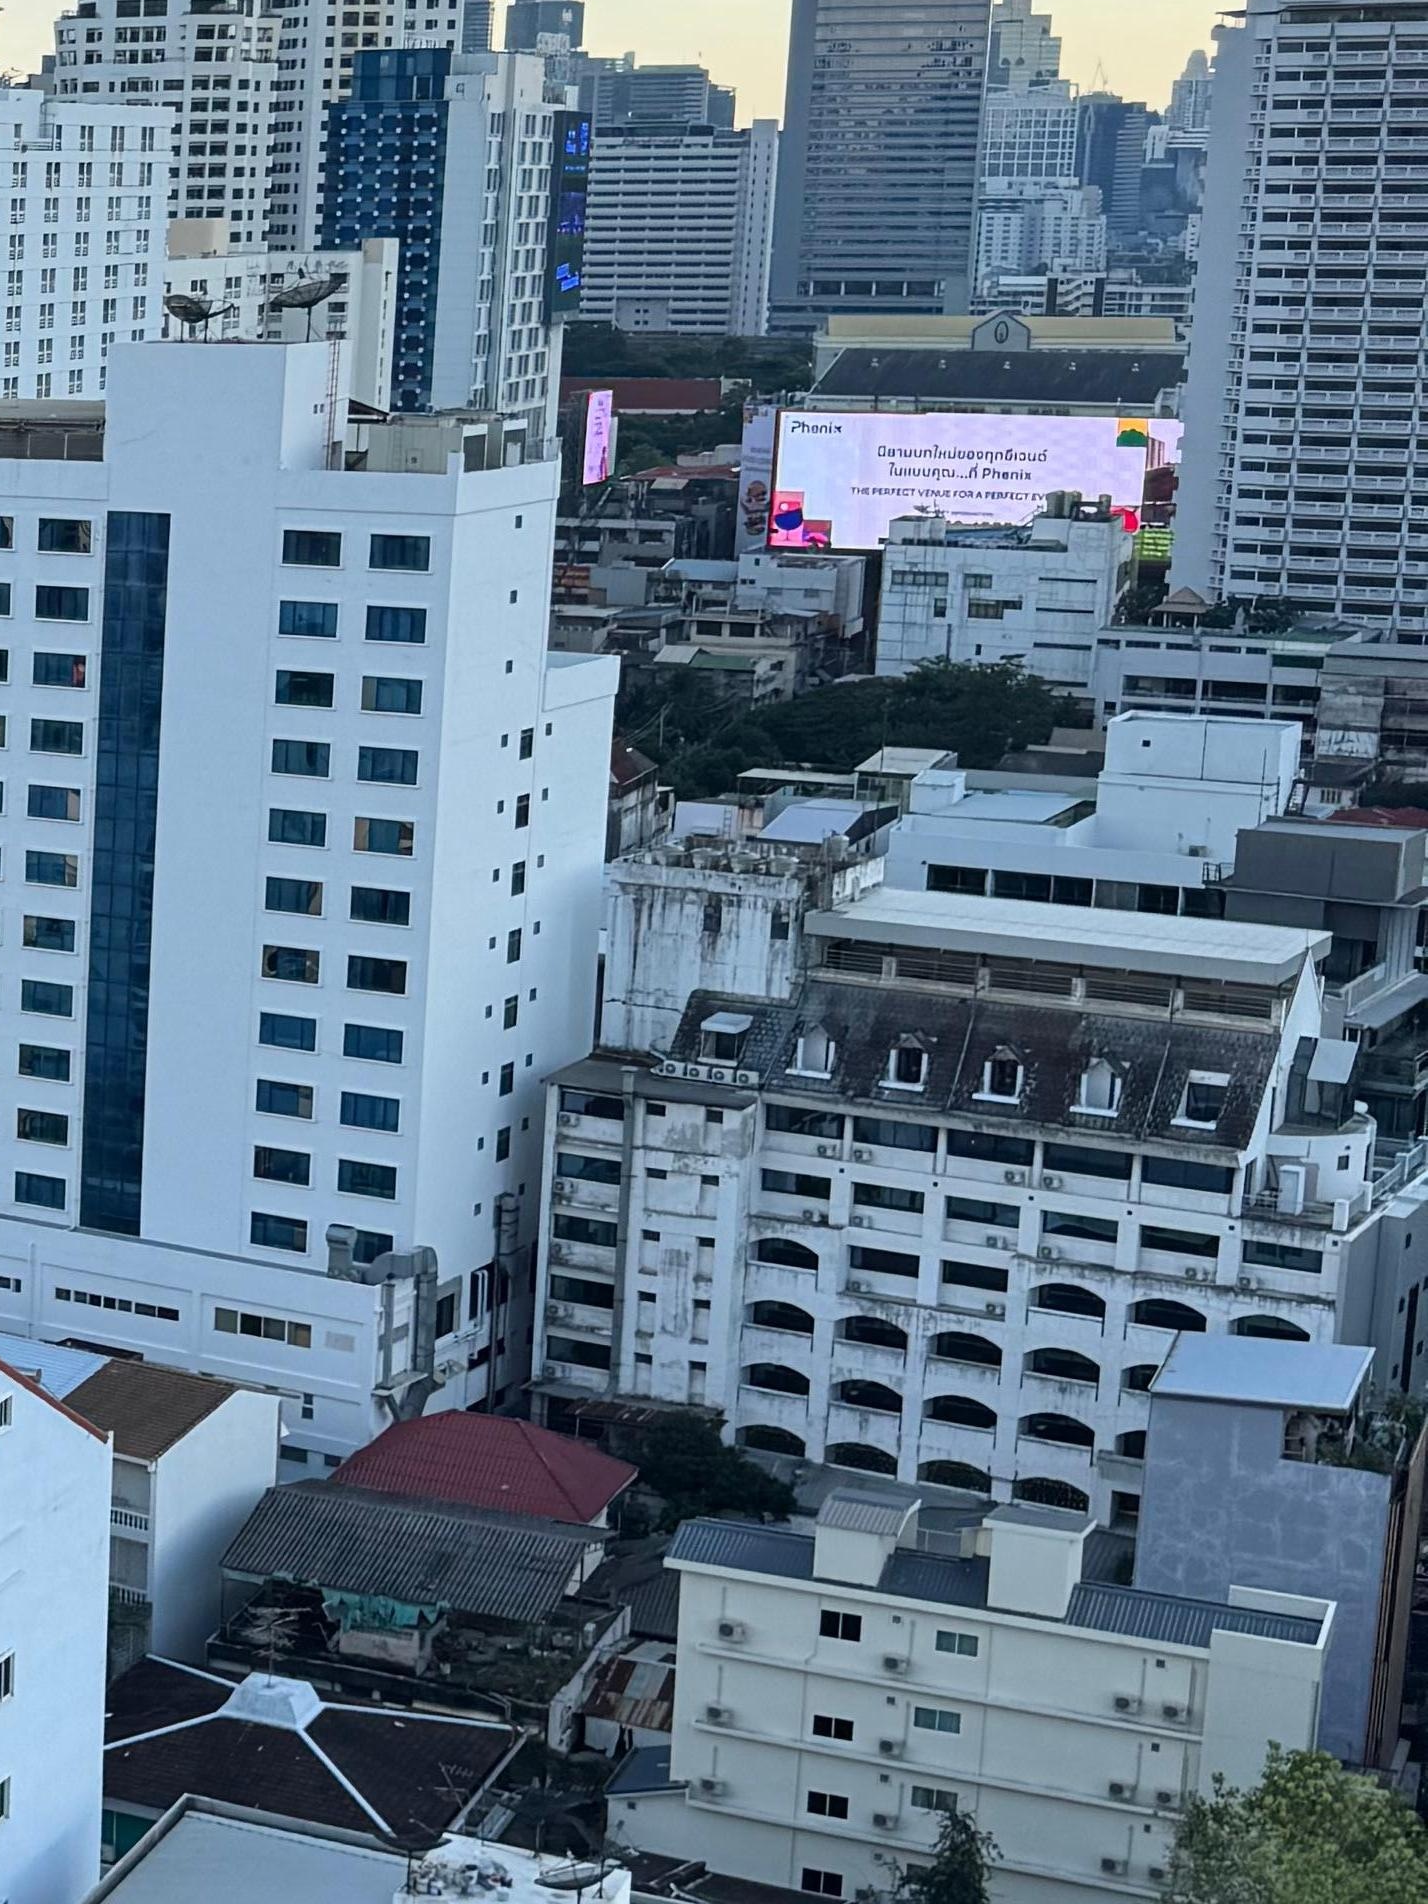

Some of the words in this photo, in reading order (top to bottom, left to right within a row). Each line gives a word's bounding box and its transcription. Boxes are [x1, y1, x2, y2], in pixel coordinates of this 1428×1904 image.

[872, 487, 916, 497] PERFECT
[918, 489, 951, 499] VENUE
[953, 491, 974, 500] FOR
[976, 491, 983, 500] A
[985, 491, 1029, 502] PERFECT
